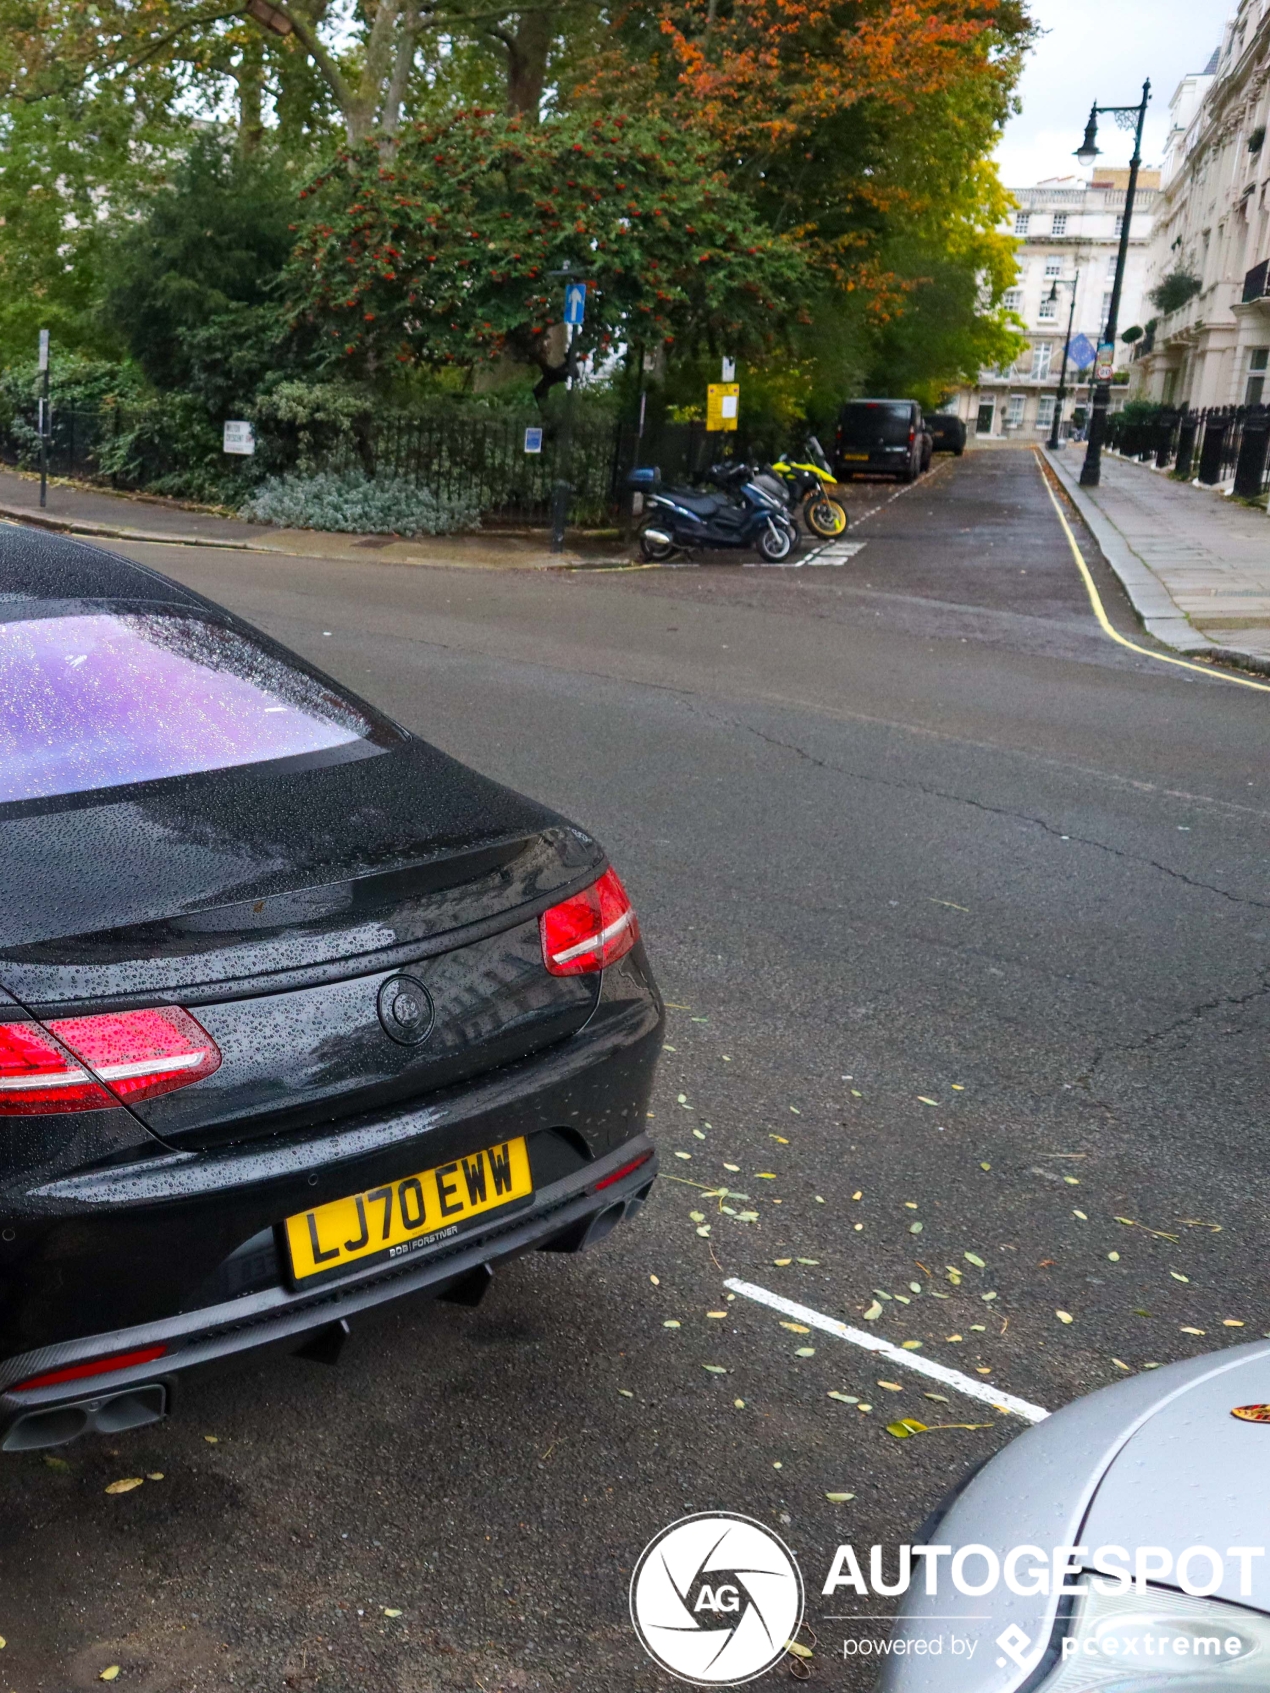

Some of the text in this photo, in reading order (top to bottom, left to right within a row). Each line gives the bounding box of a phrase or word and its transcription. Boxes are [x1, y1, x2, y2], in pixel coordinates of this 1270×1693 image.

[306, 1143, 513, 1265] LJ70 EWW
[389, 1244, 409, 1258] BOB
[412, 1225, 458, 1250] FORSTNER
